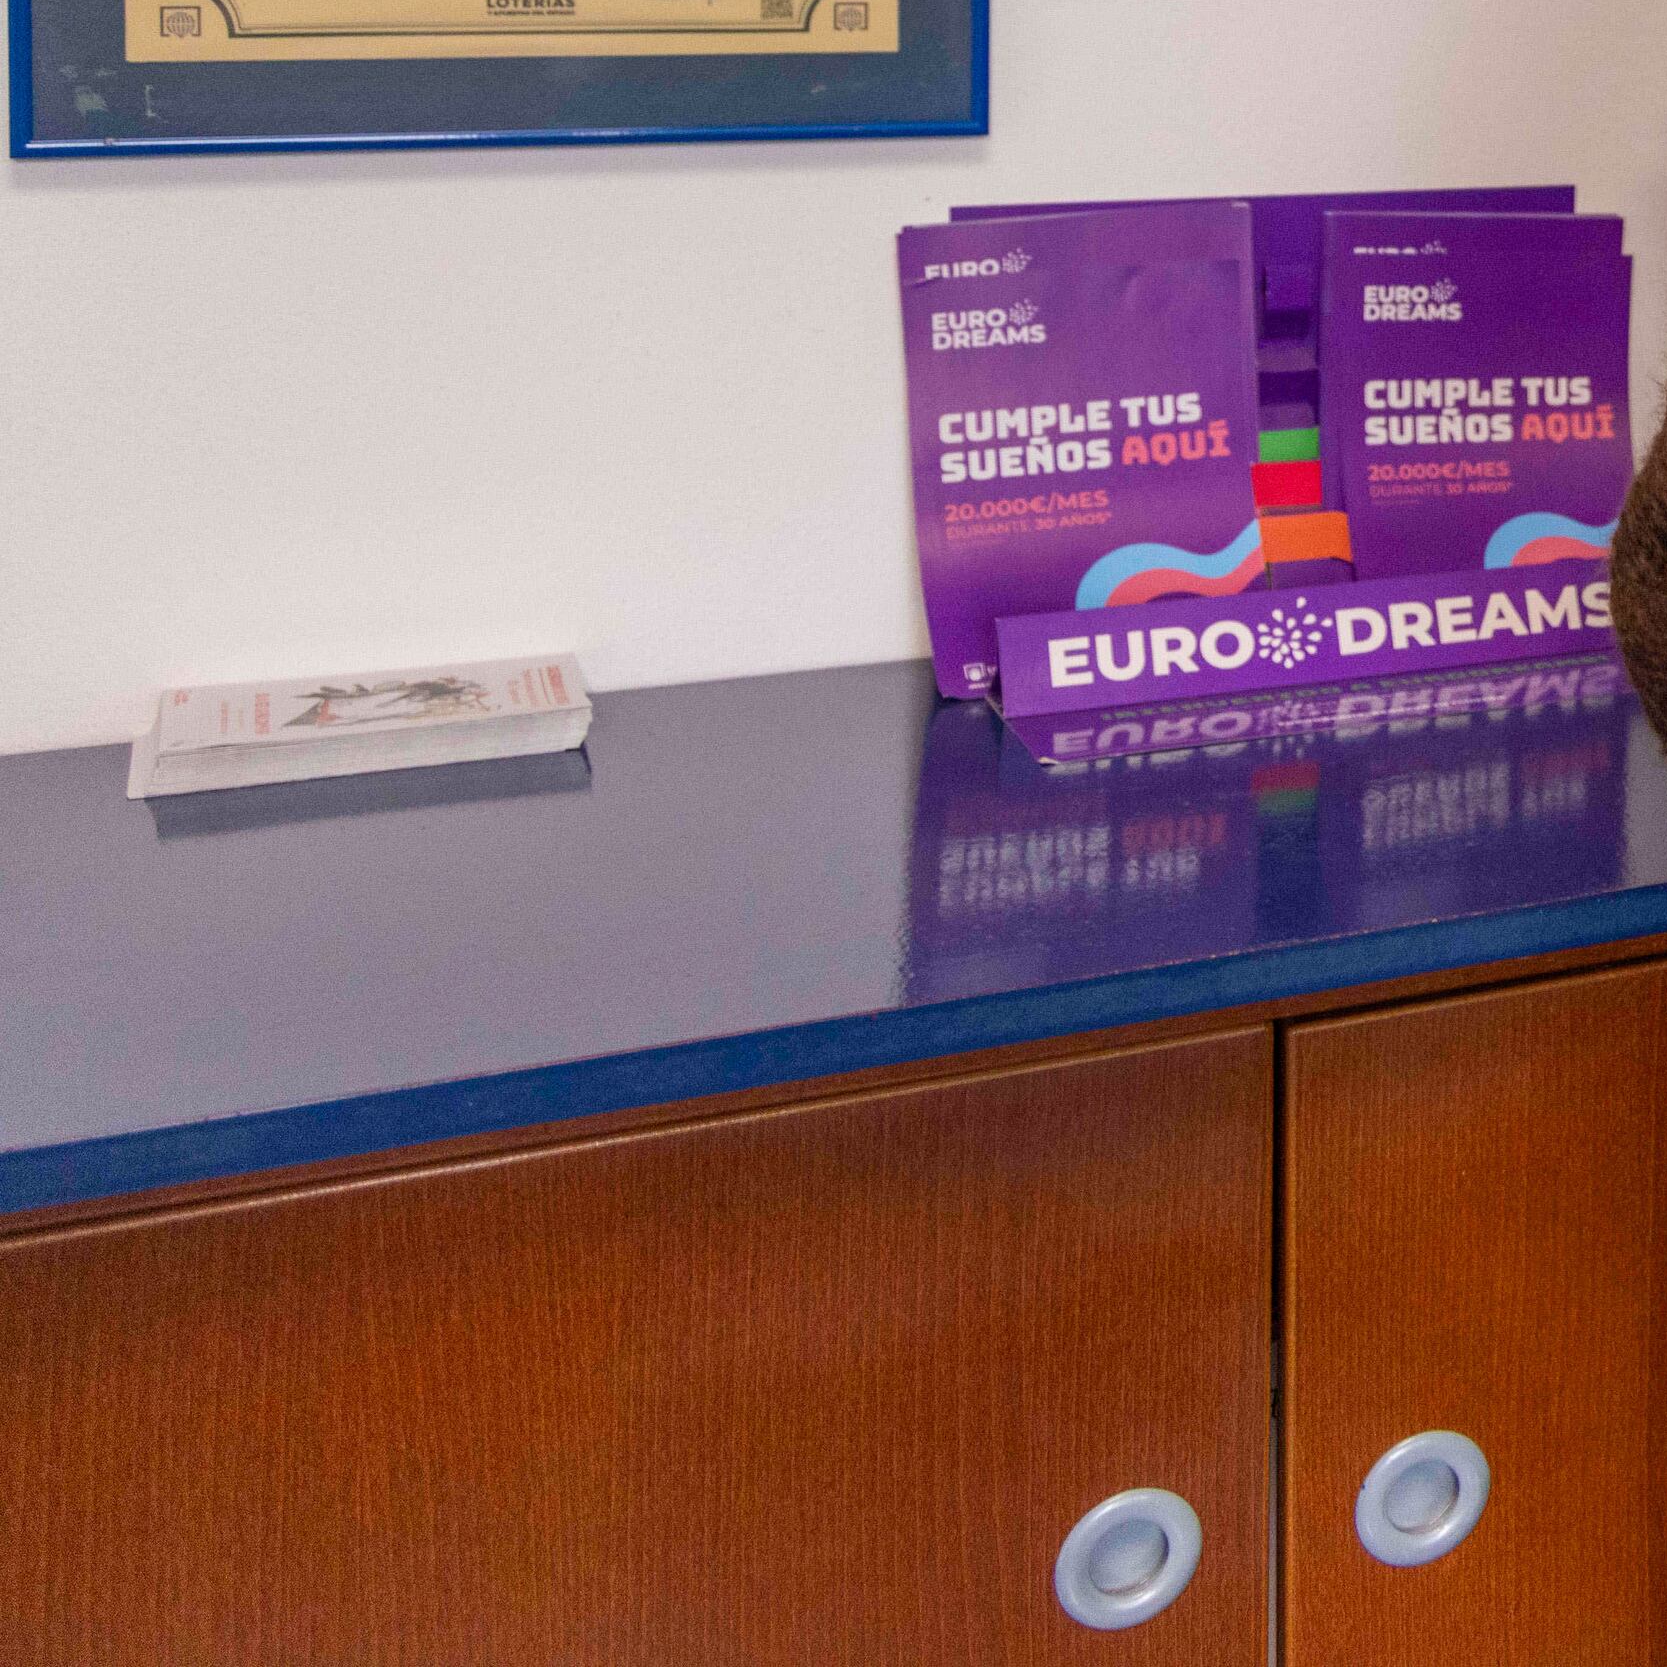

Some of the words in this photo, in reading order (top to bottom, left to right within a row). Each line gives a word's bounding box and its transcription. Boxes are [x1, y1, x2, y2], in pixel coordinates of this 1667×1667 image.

[1362, 284, 1431, 304] EURO
[931, 308, 1008, 332] EURO
[1362, 301, 1463, 322] DREAMS
[931, 323, 1047, 351] DREAMS
[1363, 377, 1516, 410] CUMPLE
[1520, 376, 1593, 407] TUS
[938, 399, 1113, 445] CUMPLE
[1119, 392, 1203, 428] TUS
[1363, 408, 1515, 447] SUEÑOS
[1520, 403, 1616, 444] AQUÍ
[938, 436, 1113, 484] SUEÑOS
[1120, 419, 1231, 466] AQUÍ
[1367, 459, 1512, 482] 20.000€/MES
[943, 489, 1110, 523] 20.000€/MES
[1047, 620, 1256, 689] EURO
[1333, 581, 1614, 658] DREAMS
